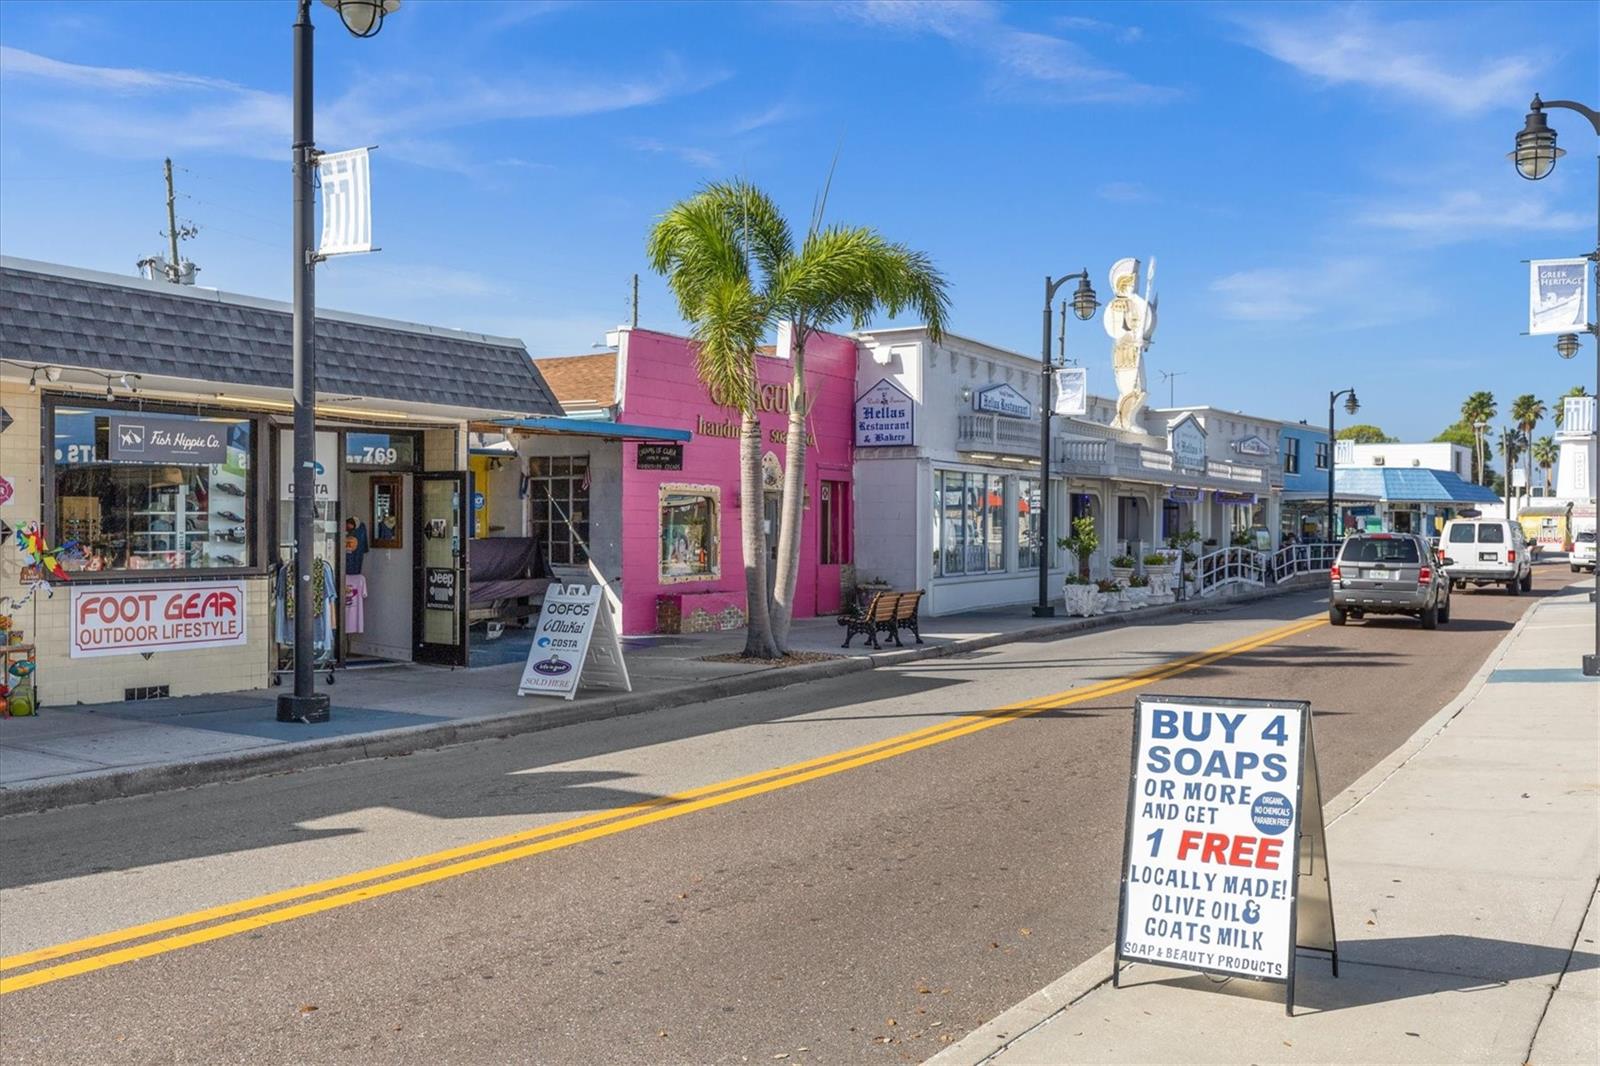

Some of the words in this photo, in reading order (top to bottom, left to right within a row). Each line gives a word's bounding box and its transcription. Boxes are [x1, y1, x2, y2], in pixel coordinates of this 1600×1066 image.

[1541, 271, 1567, 279] GREEK
[1541, 279, 1582, 287] HERITAGE
[863, 407, 905, 419] Hellas
[859, 421, 909, 431] Restaurant
[150, 430, 171, 446] Fish
[173, 432, 206, 450] Hippie
[207, 434, 220, 448] Co.
[864, 435, 871, 443] &
[875, 433, 905, 443] Bakery
[363, 446, 397, 464] 769
[430, 570, 454, 587] Jeep
[80, 595, 157, 625] FOOT
[164, 591, 236, 621] GEAR
[547, 603, 590, 616] OOFOS
[80, 625, 158, 645] OUTDOOR
[162, 620, 237, 640] LIFESTYLE
[551, 638, 578, 648] COSTA
[526, 678, 547, 686] SOLD
[547, 679, 570, 687] HERE
[1152, 709, 1247, 744] BUY
[1261, 715, 1288, 747] 4
[1146, 745, 1288, 782] SOAPS
[1144, 778, 1176, 800] OR
[1183, 782, 1252, 805] MORE
[1262, 796, 1284, 805] ORGANIC
[1142, 802, 1179, 820] AND
[1185, 805, 1219, 824] GET
[1254, 806, 1262, 814] NO
[1263, 807, 1290, 816] CHEMICALS
[1254, 816, 1277, 825] PARABEN
[1277, 818, 1289, 827] FREE
[1146, 828, 1164, 858] 1
[1177, 830, 1284, 870] FREE
[1131, 864, 1217, 892] LOCALLY
[1223, 876, 1288, 901] MADE!
[1152, 894, 1206, 918] OLIVE
[1145, 917, 1212, 945] GOATS
[1217, 927, 1264, 951] MILK
[1124, 941, 1155, 956] SOAP
[1156, 947, 1163, 957] &
[1166, 947, 1215, 965] BEAUTY
[1217, 955, 1283, 976] PRODUCTS
